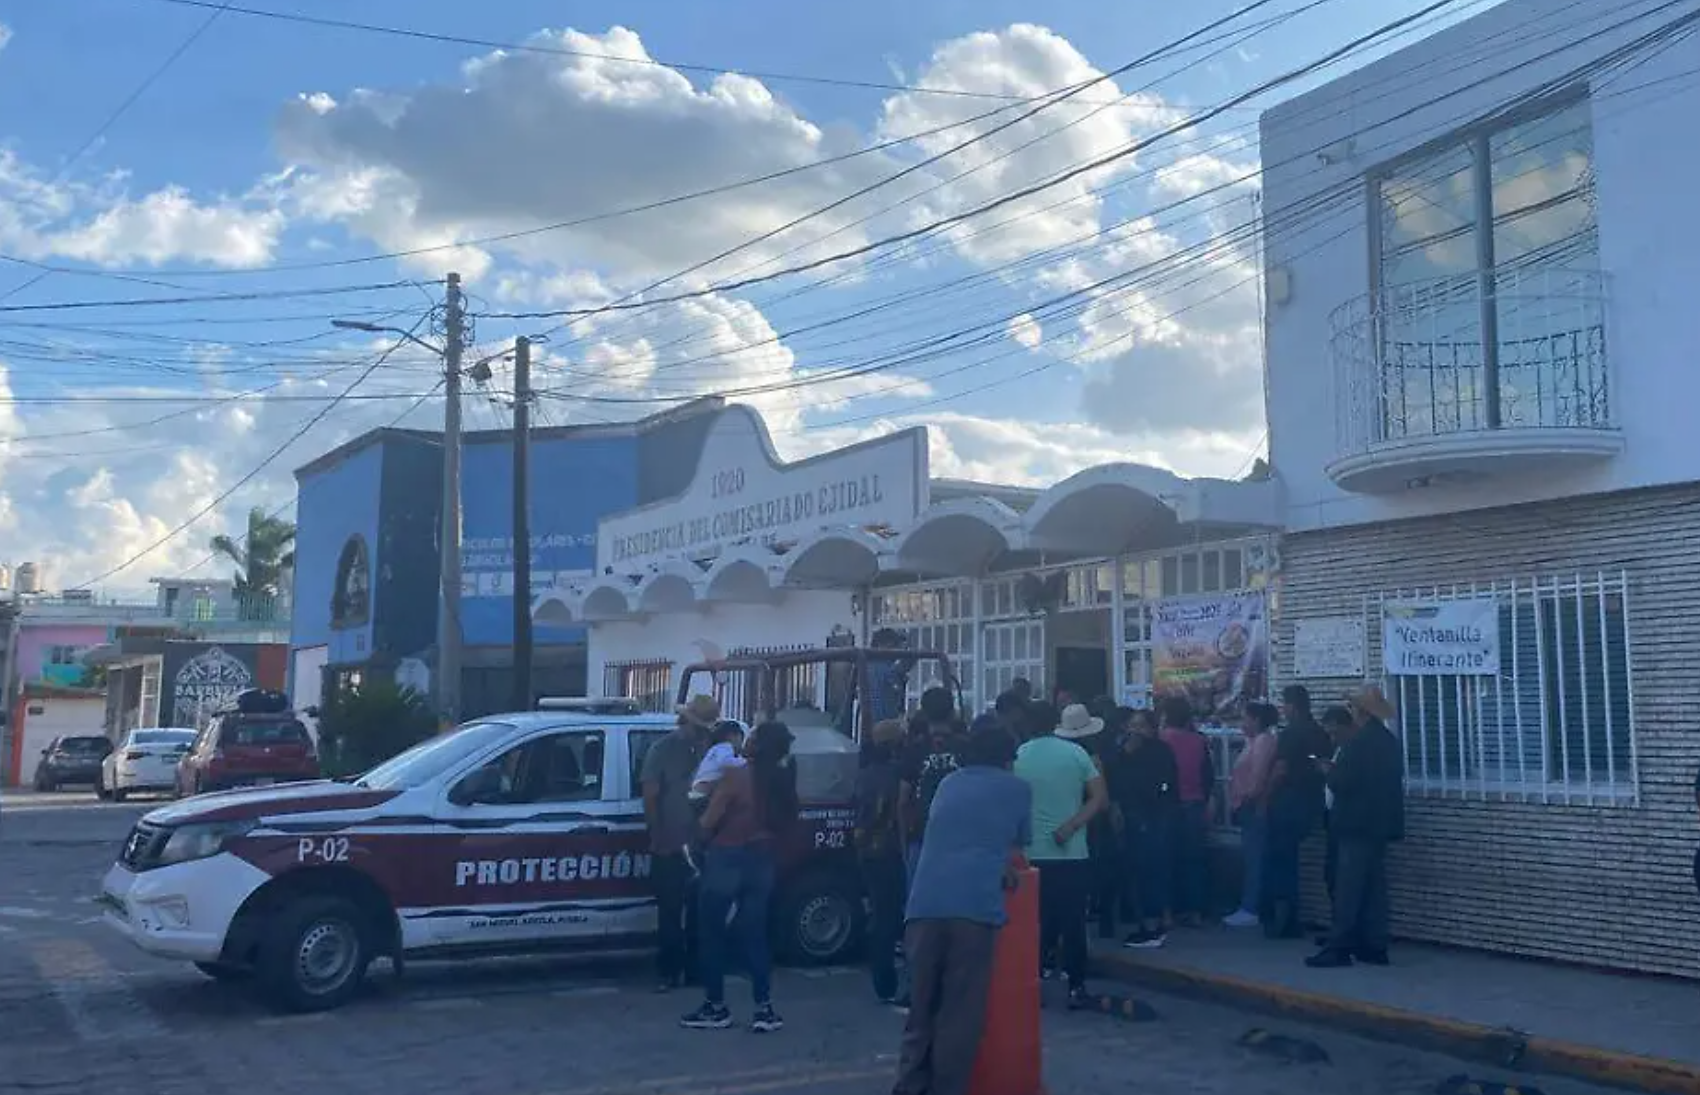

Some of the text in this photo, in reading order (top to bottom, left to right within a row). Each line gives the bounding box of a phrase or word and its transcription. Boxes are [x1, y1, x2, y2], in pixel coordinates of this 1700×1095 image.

[711, 467, 745, 498] 1920
[612, 474, 883, 561] PRESIDENCIA DEL COMISARIADO EJIDAL
[298, 837, 349, 862] P-02
[455, 852, 651, 886] PROTECCIÓN
